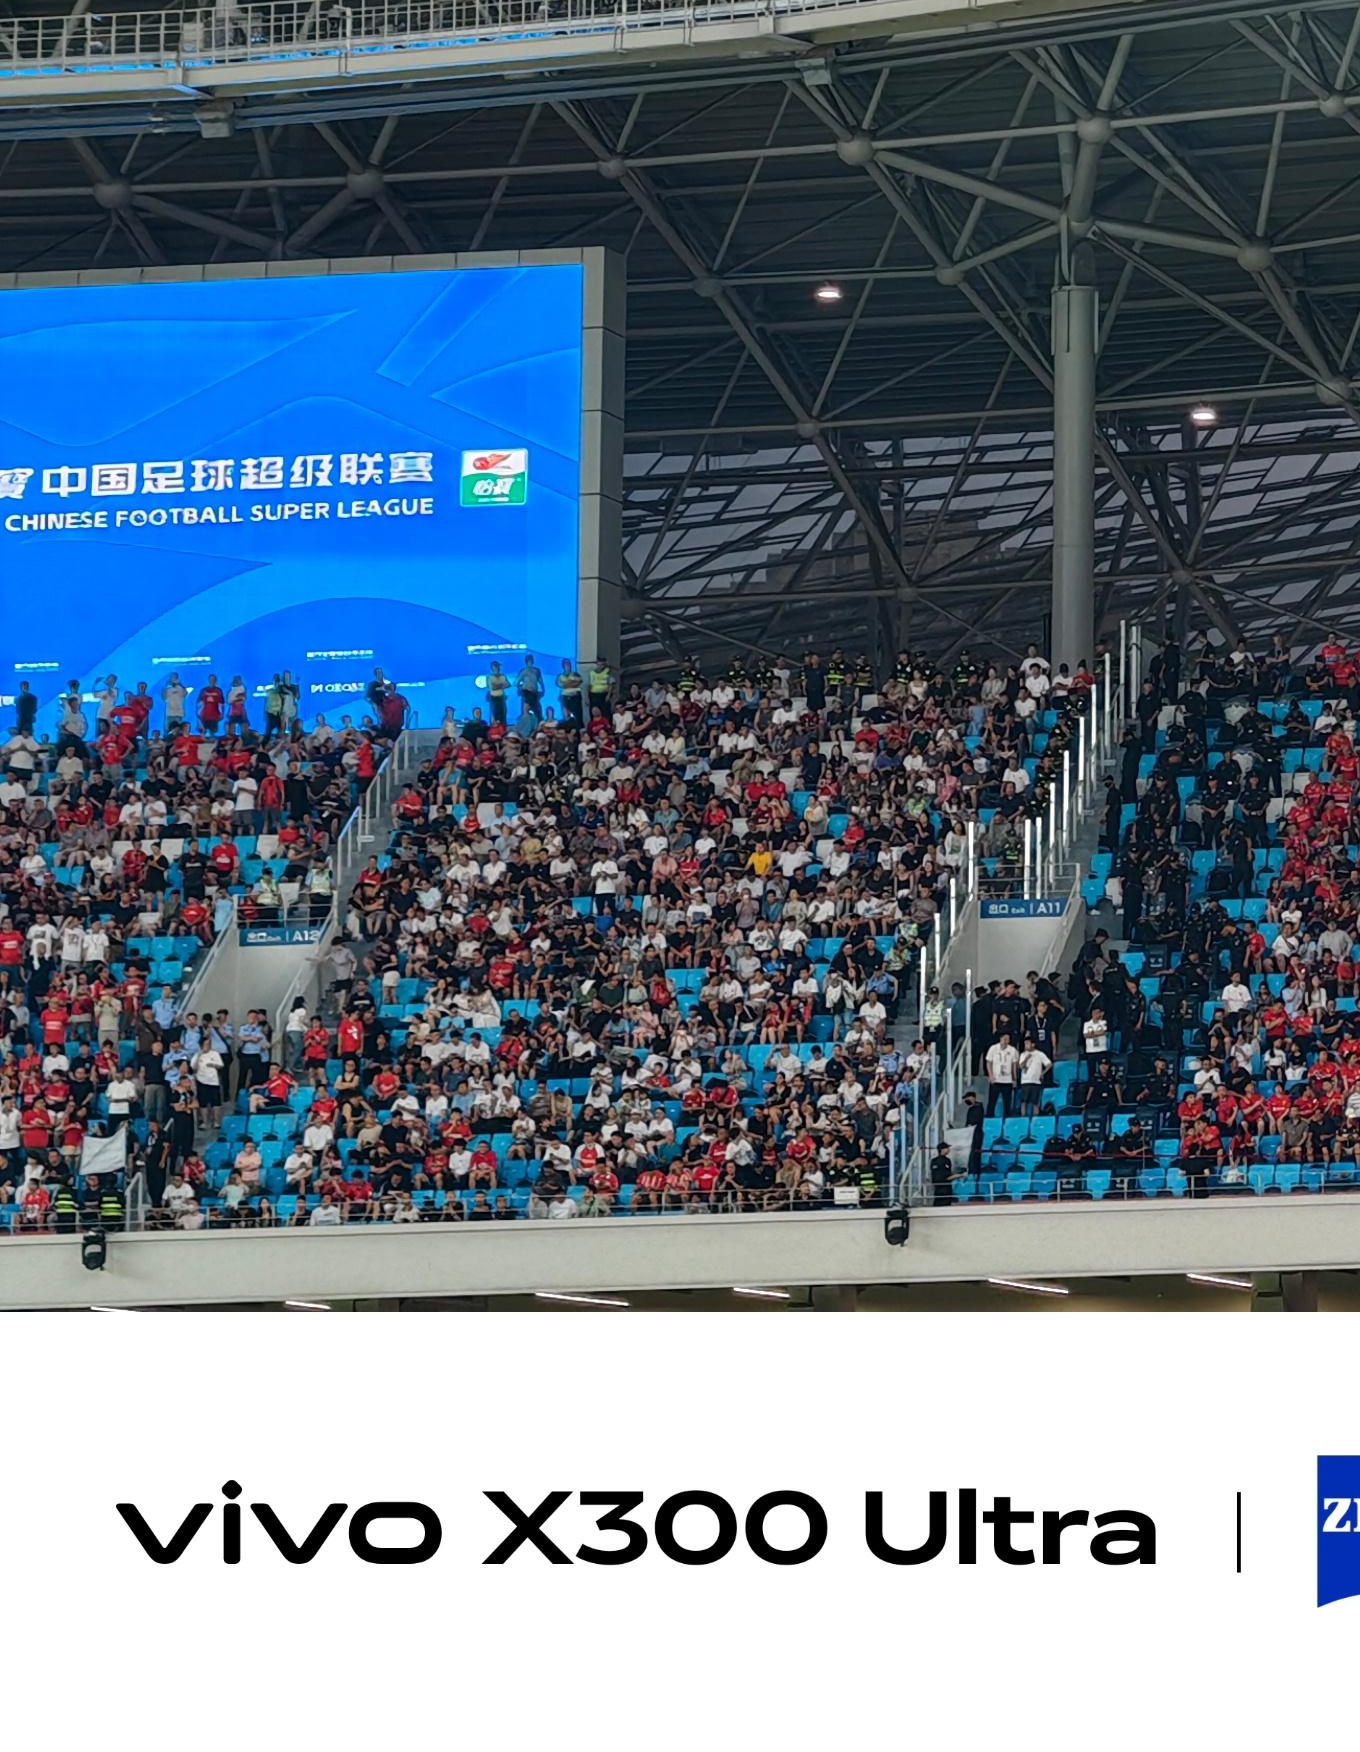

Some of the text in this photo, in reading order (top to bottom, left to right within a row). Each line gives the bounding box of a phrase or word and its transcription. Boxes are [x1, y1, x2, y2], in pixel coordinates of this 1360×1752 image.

[5, 498, 433, 532] CHINESE FOOTBALL SUPER LEAGUE
[1036, 901, 1060, 914] A11
